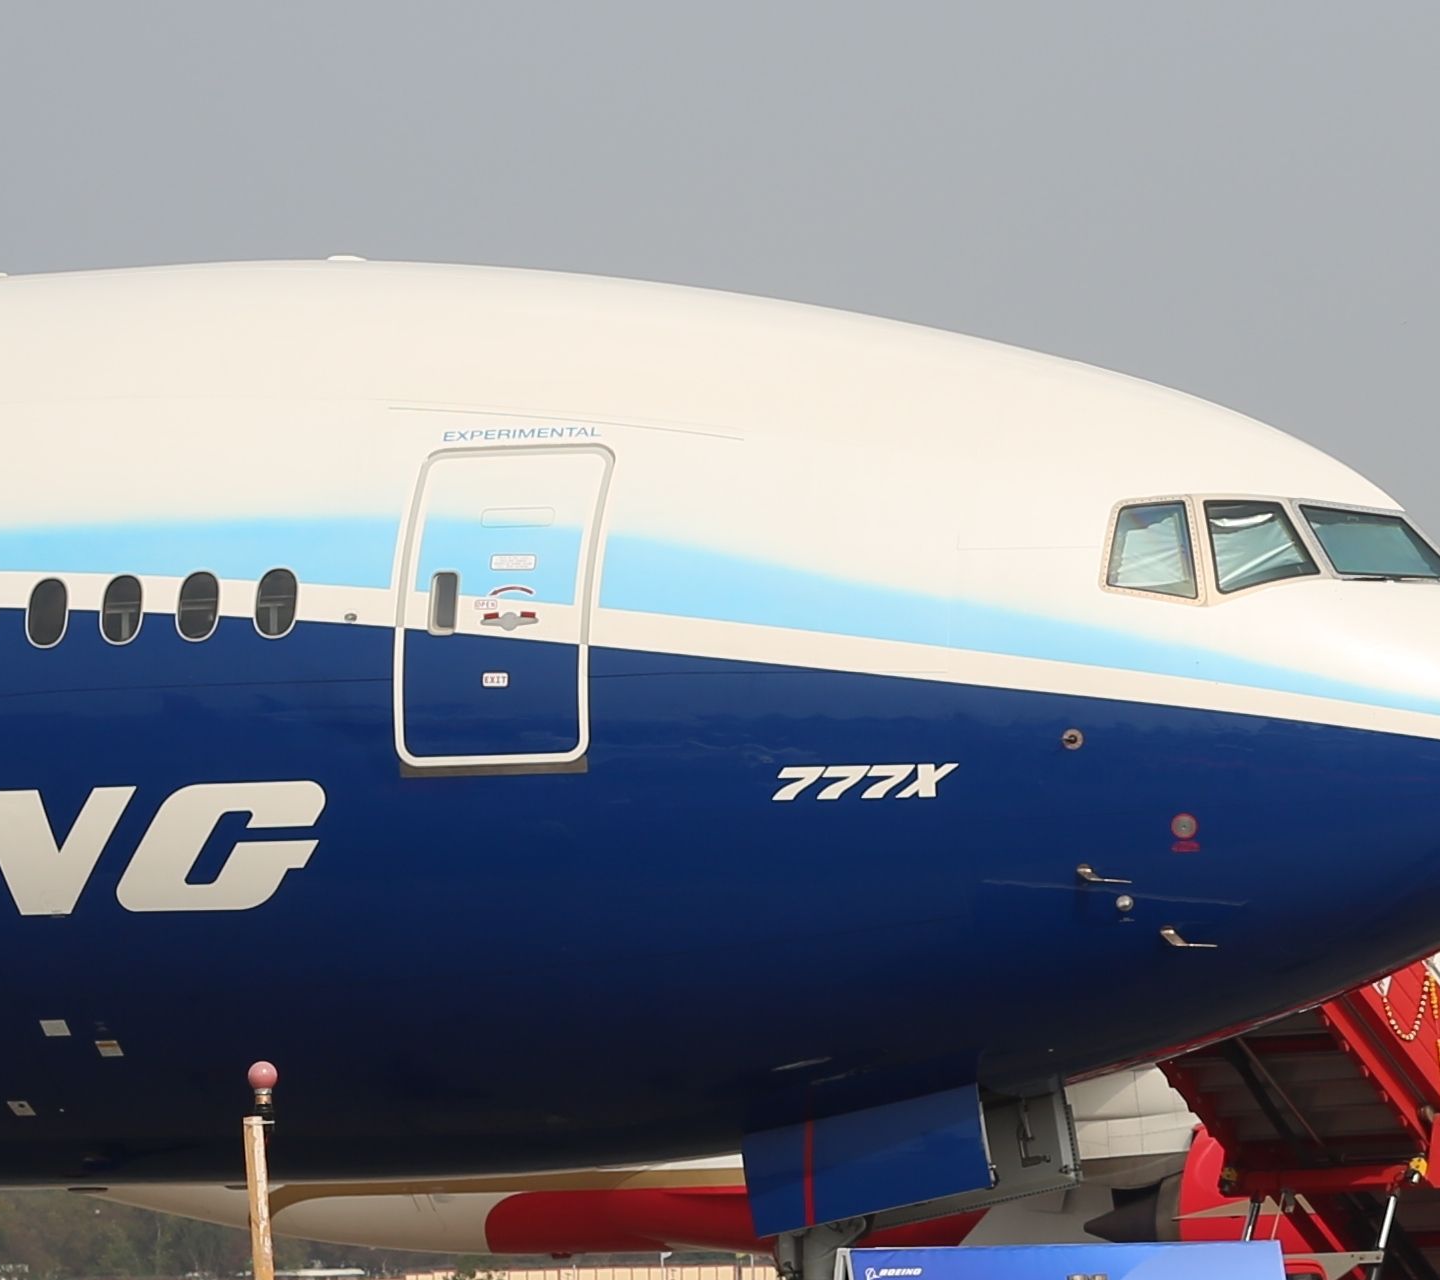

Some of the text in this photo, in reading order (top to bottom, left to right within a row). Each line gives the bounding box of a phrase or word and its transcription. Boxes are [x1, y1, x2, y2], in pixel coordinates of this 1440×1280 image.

[442, 427, 602, 442] EXPERIMENTAL
[484, 675, 508, 685] EXIT
[772, 763, 958, 801] 777X
[879, 1267, 922, 1277] BOEING
